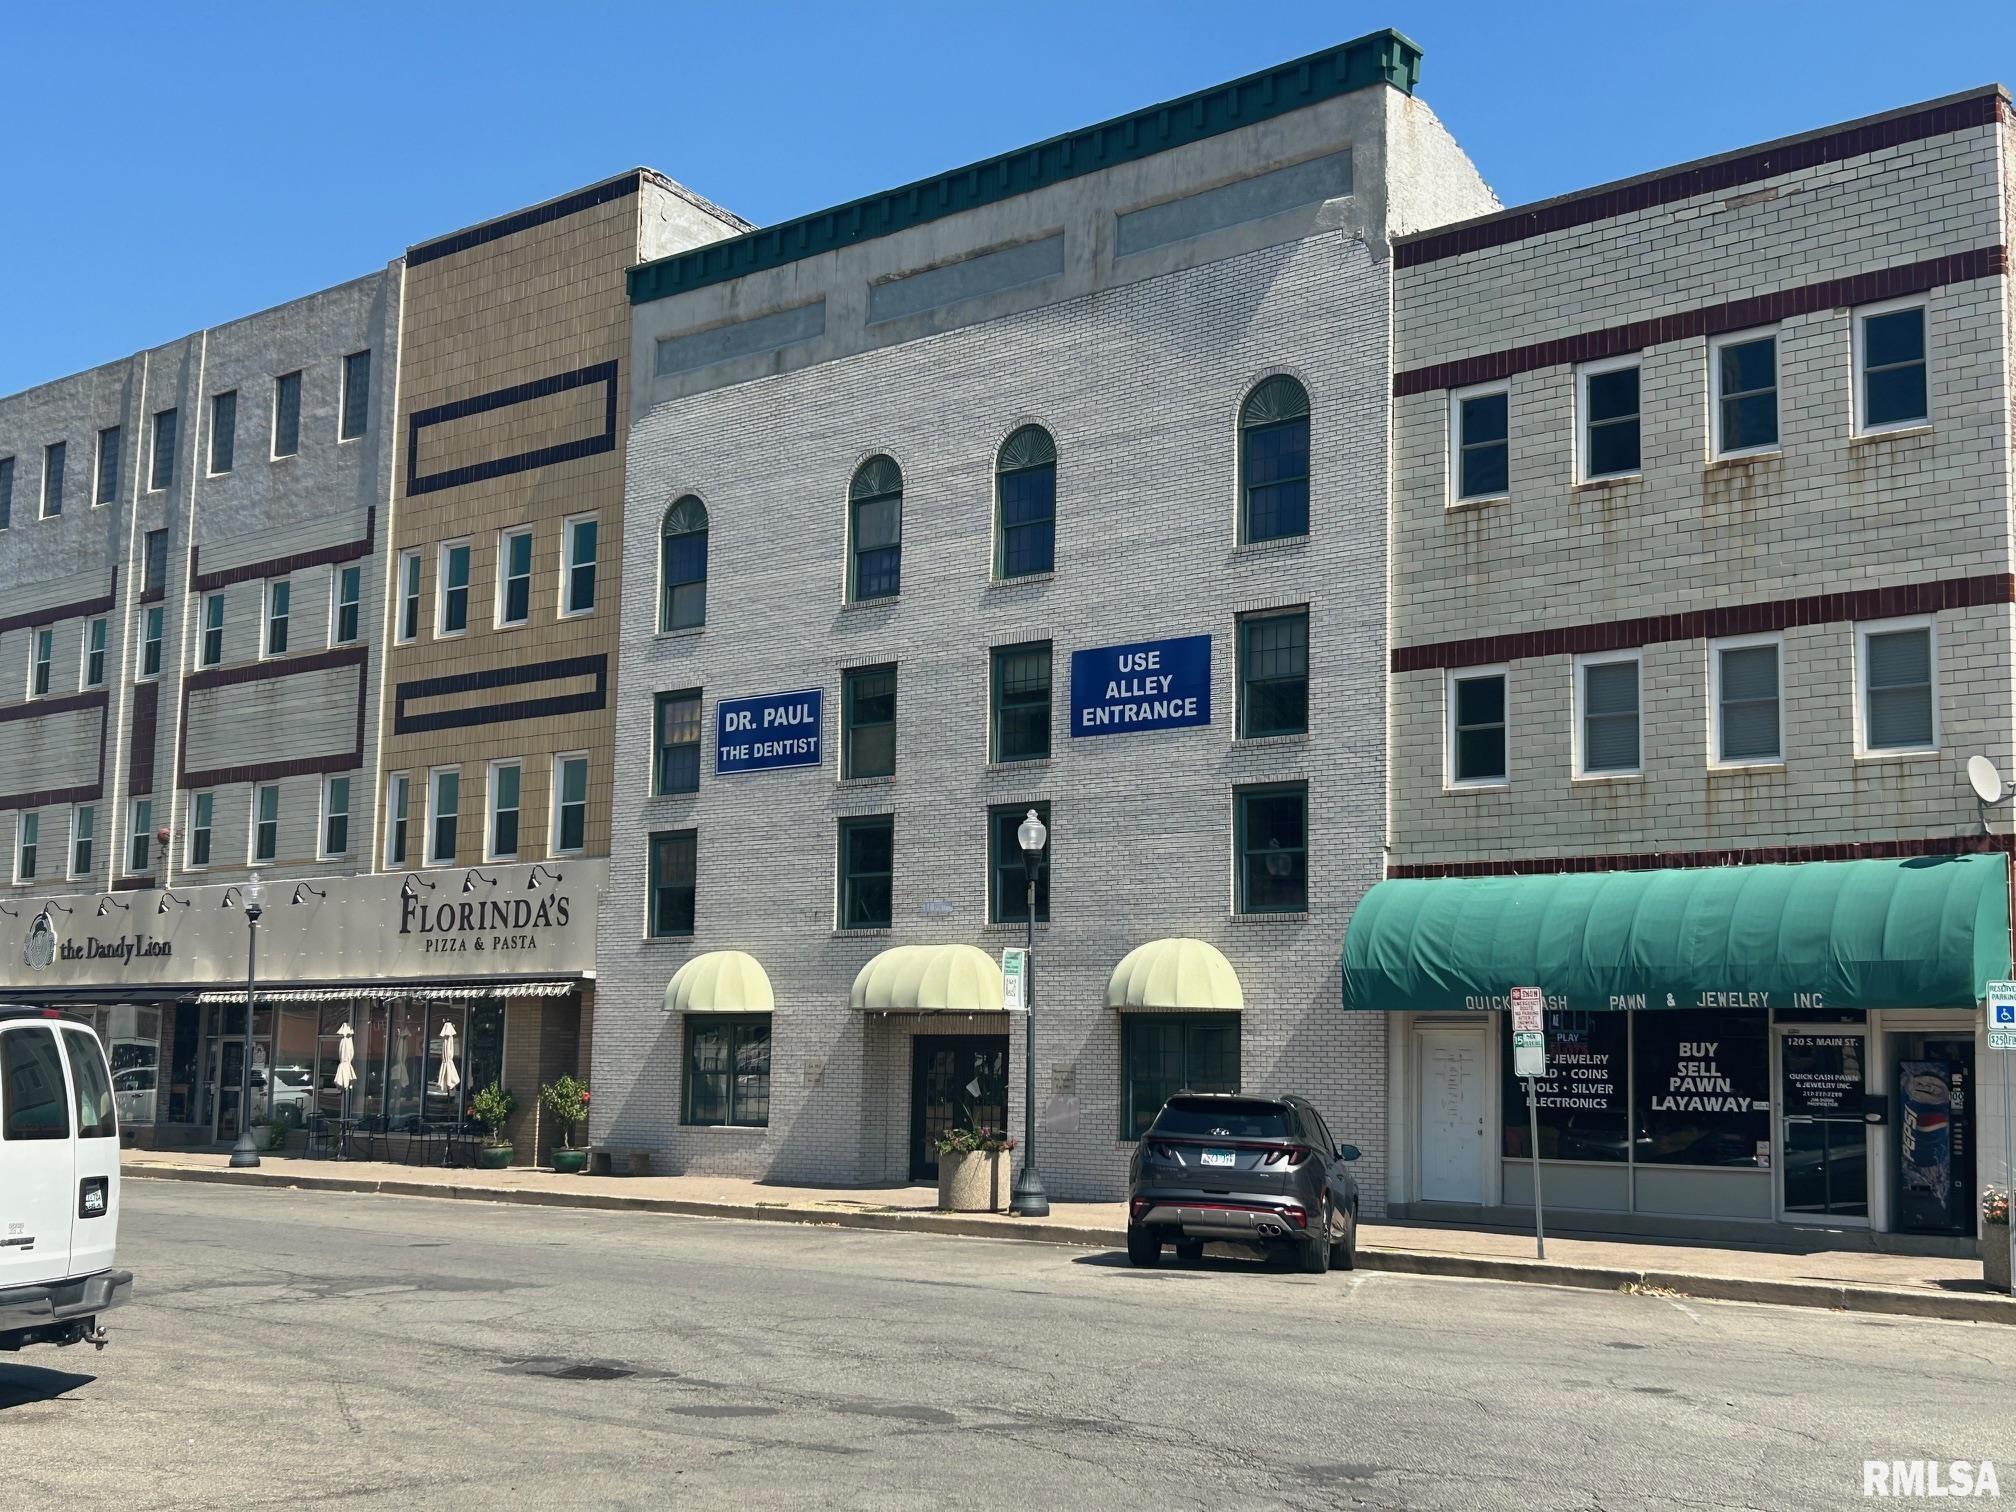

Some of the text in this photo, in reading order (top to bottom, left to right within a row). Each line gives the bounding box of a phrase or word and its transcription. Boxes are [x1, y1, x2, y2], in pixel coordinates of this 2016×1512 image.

[1119, 651, 1160, 672] USE
[1105, 675, 1173, 699] ALLEY
[725, 704, 814, 732] DR. PAUL
[1082, 697, 1198, 726] ENTRANCE
[720, 737, 817, 761] THE DENTIST
[400, 893, 570, 934] FLORINDA'S
[60, 934, 172, 966] the Dandy Lion
[426, 935, 537, 952] PIZZA & PASTA
[1990, 984, 2016, 993] RESERVE
[1465, 991, 1823, 1011] QUICK ASH PAWN & JEWELRY INC
[1557, 1033, 1579, 1042] PLAY
[1788, 1037, 1804, 1046] 120
[1816, 1038, 1842, 1046] MAIN
[1679, 1042, 1718, 1057] BUY
[1552, 1054, 1609, 1065] JEWELRY
[1570, 1068, 1608, 1079] COINS
[1677, 1061, 1721, 1077] SELL
[1520, 1082, 1614, 1095] TOLS SILVER
[1669, 1077, 1731, 1093] PAWN
[1651, 1095, 1751, 1113] LAYAWAY
[1903, 1104, 1918, 1162] PEPSI
